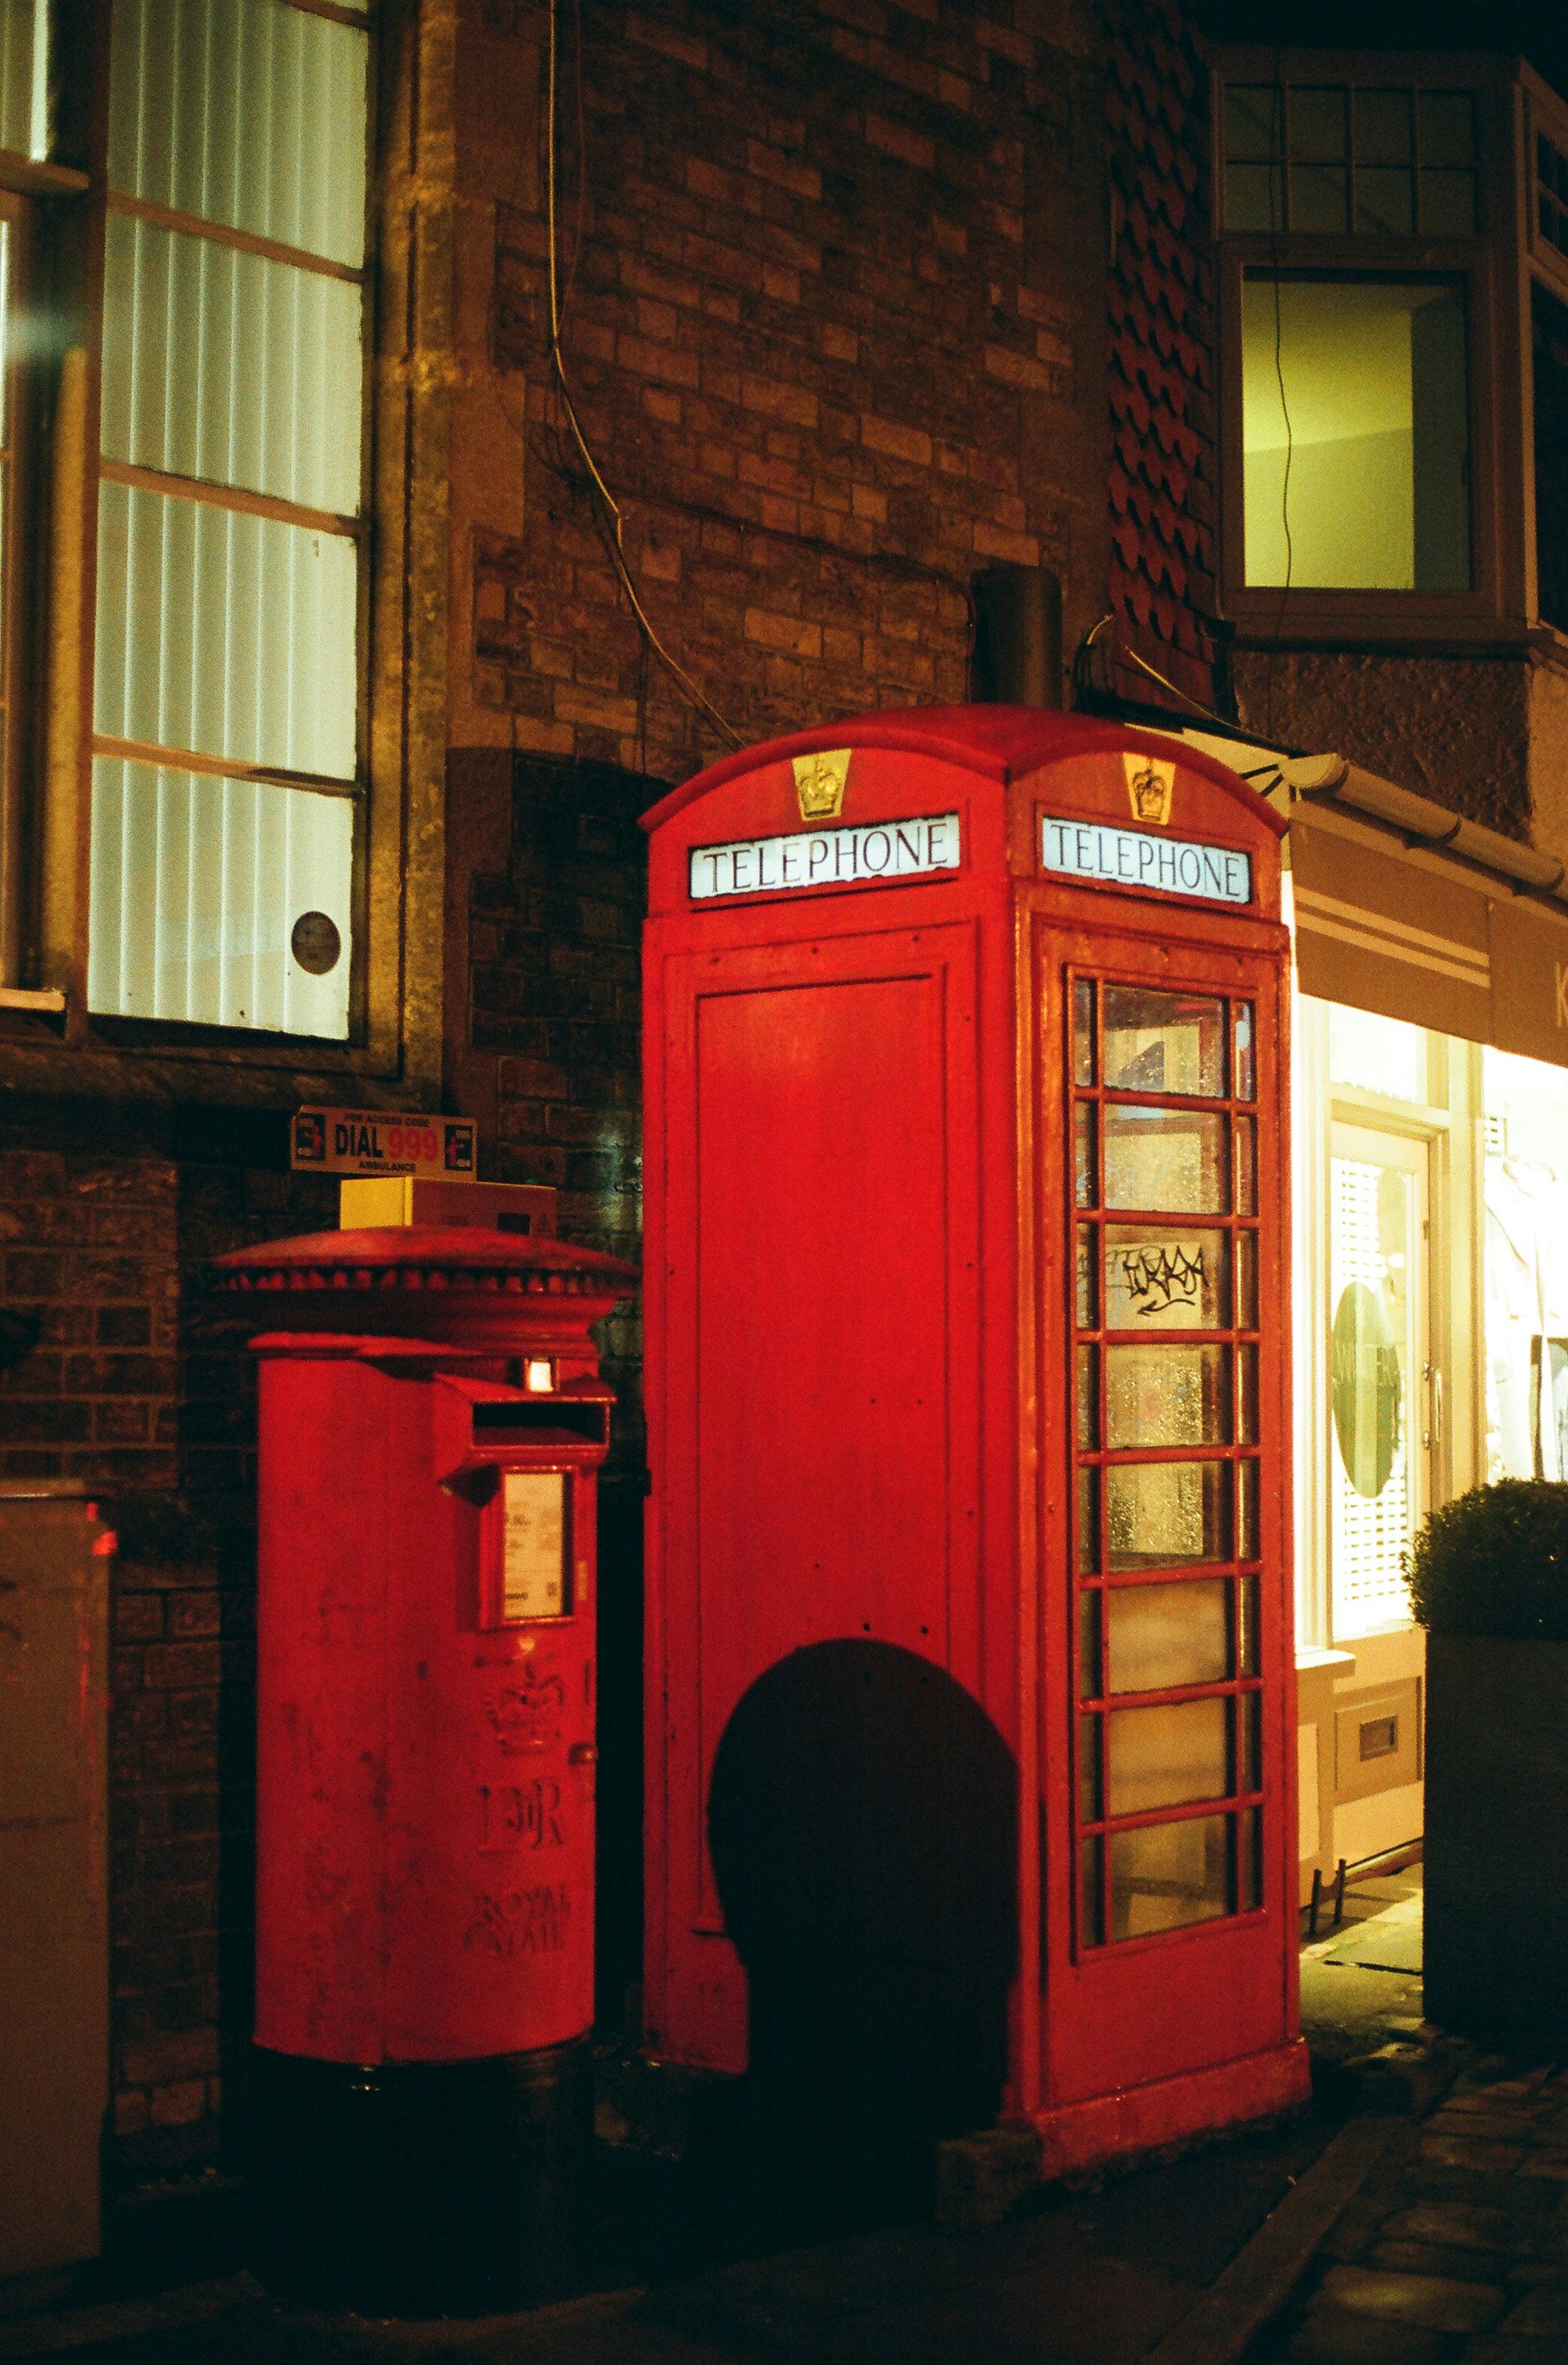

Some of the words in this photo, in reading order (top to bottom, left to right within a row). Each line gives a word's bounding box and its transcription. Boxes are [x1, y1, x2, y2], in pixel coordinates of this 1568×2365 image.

[704, 822, 948, 892] TELEPHONE
[1051, 824, 1240, 897] TELEPHONE
[335, 1124, 384, 1158] DIAL
[387, 1127, 438, 1162] 999
[359, 1161, 416, 1172] AMBULANCE
